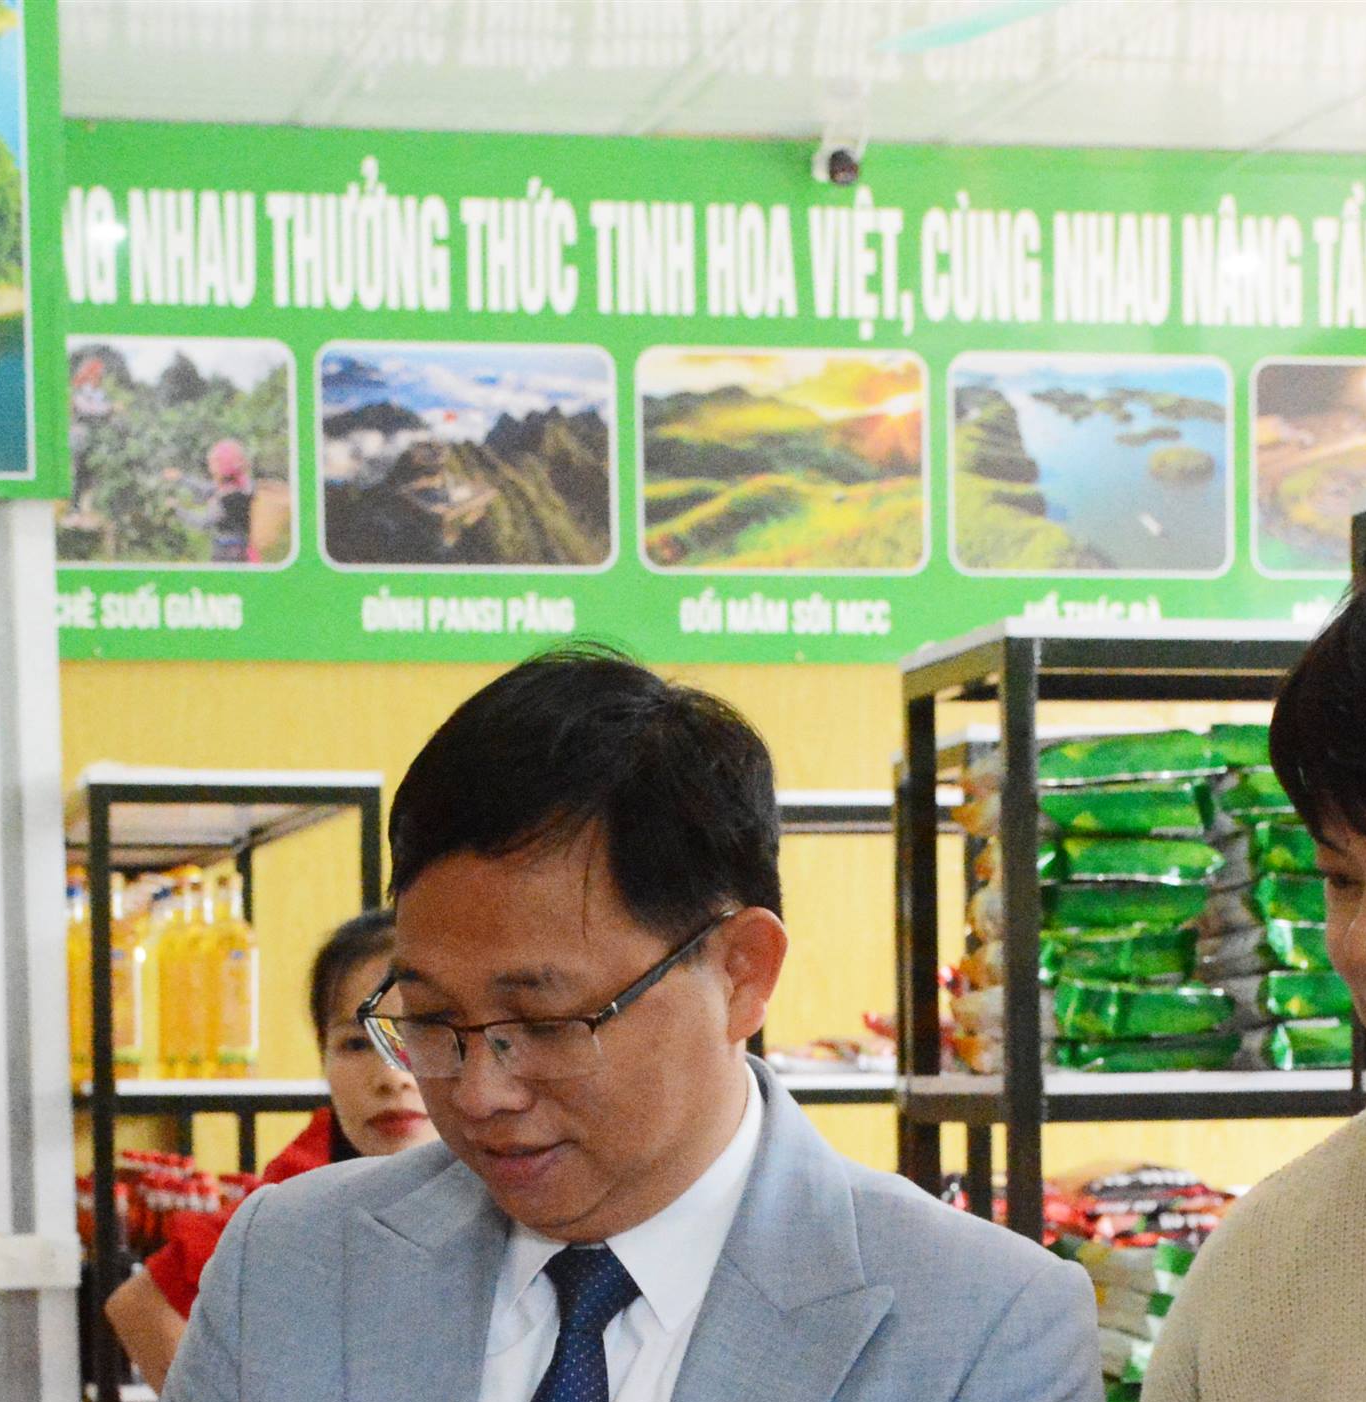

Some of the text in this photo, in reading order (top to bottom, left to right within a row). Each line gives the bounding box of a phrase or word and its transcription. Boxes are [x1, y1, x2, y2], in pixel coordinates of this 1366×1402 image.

[129, 187, 256, 308] NHAU
[265, 156, 449, 312] THƯỞNG
[460, 177, 579, 315] THỨC
[590, 200, 695, 317] TINH
[706, 202, 798, 318] HOA
[921, 190, 1042, 323] CÙNG
[1053, 211, 1171, 326] NHAU
[1182, 194, 1303, 326] NÂNG
